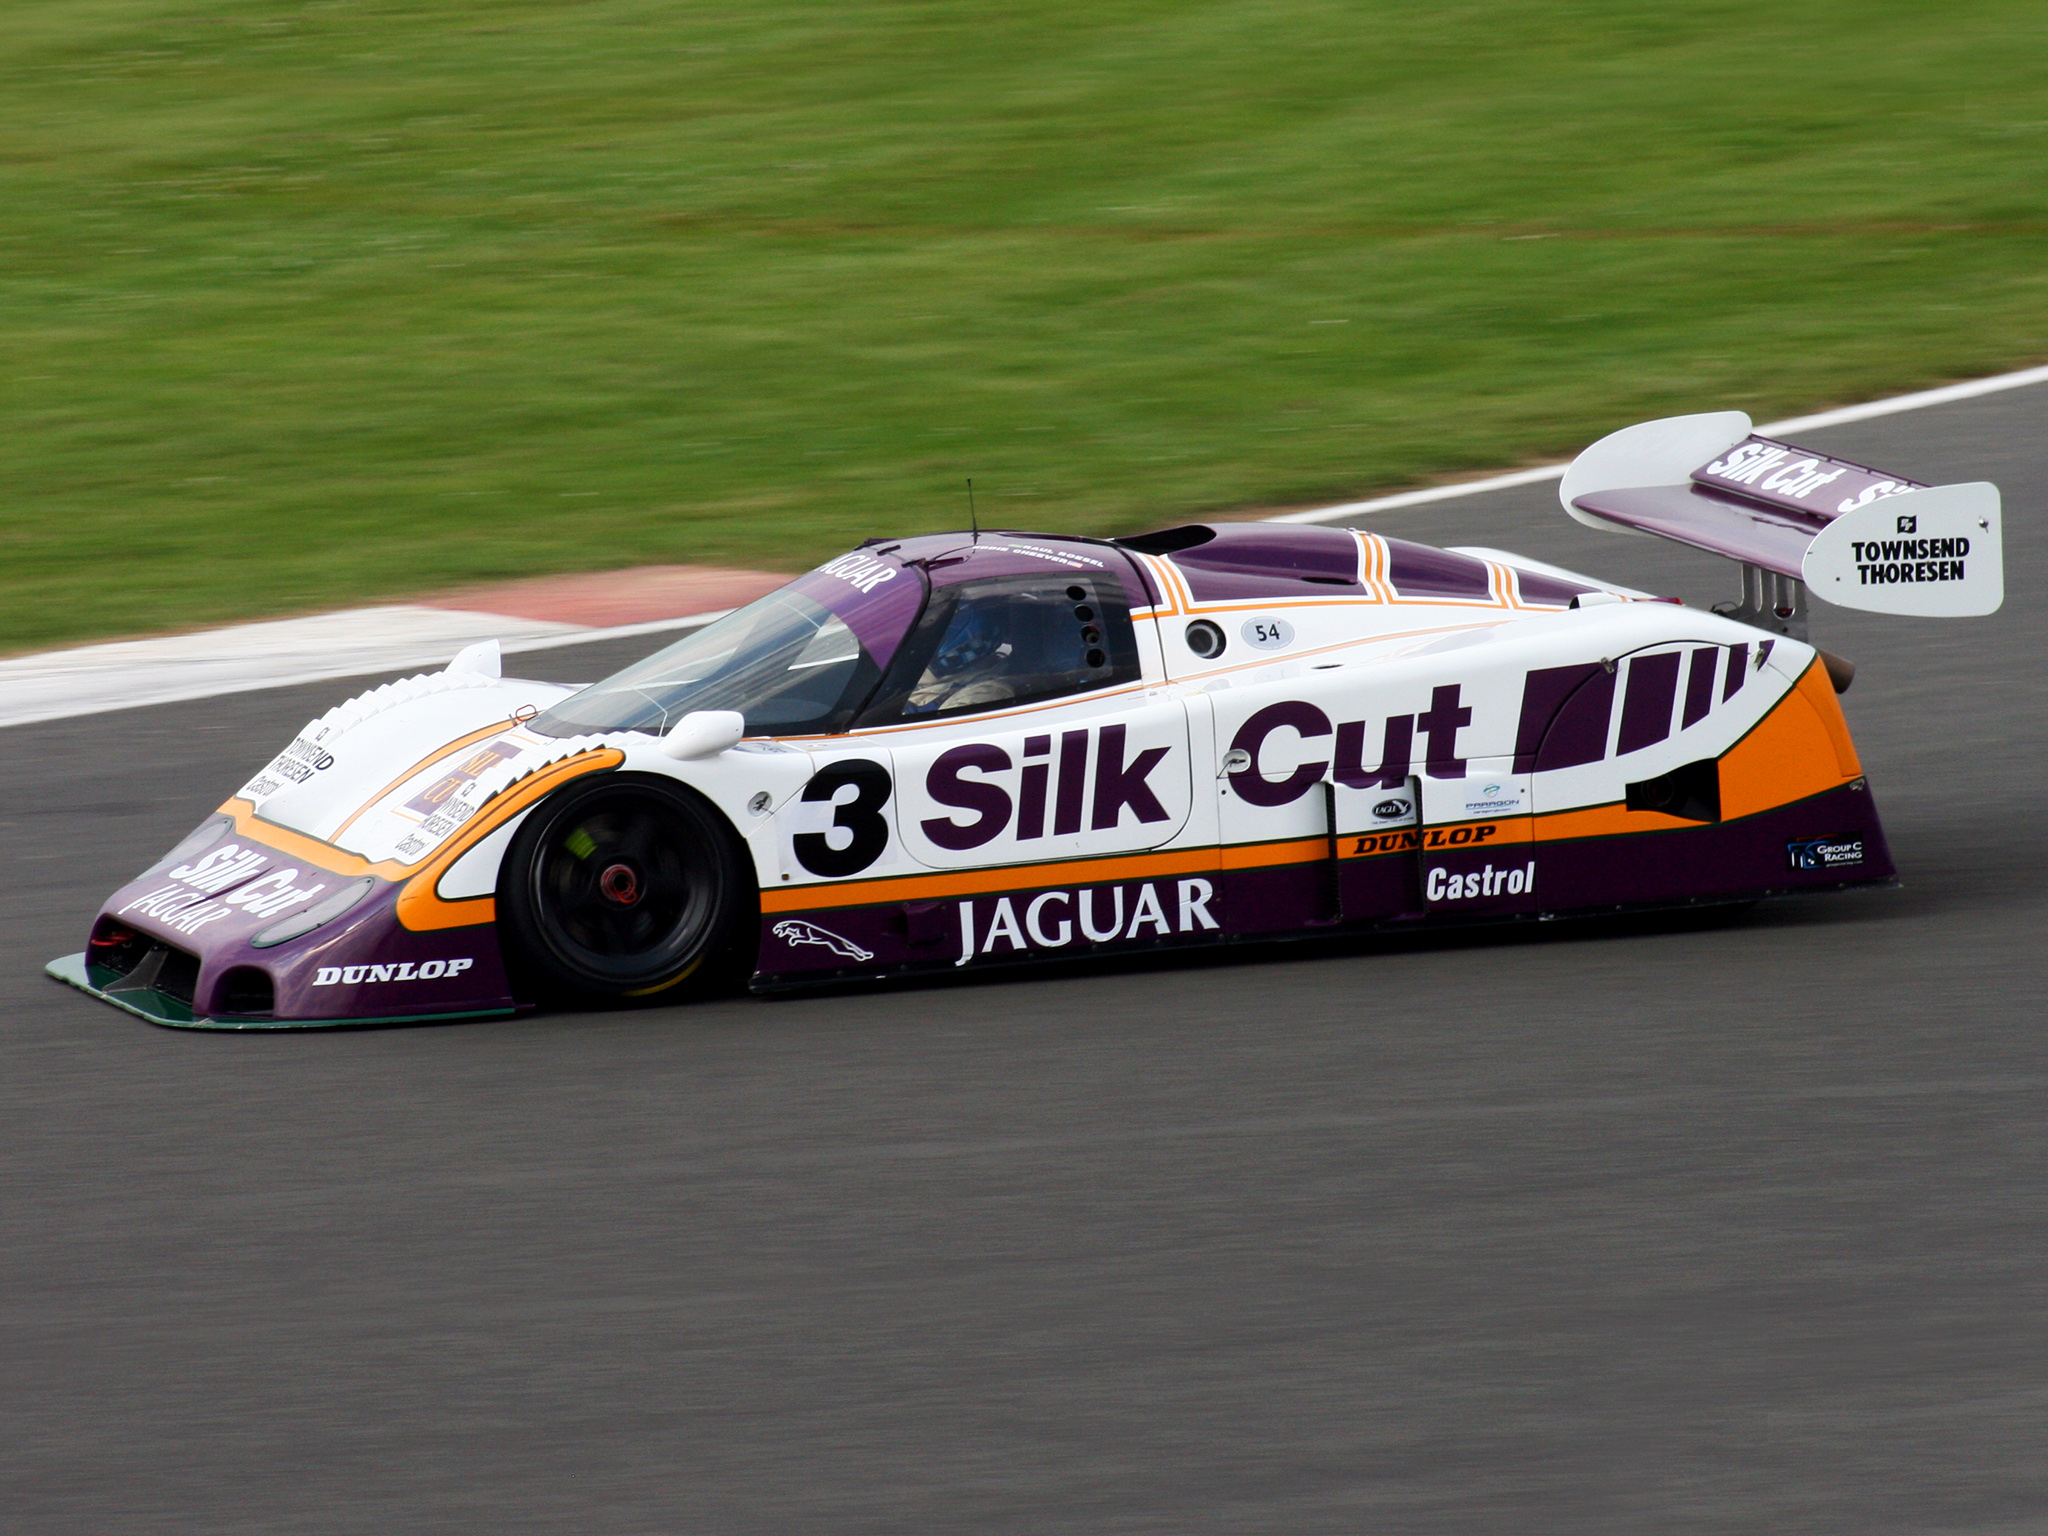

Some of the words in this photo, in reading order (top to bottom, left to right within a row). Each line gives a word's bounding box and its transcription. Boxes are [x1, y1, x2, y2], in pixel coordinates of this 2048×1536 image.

[1706, 443, 1790, 485] Silk
[1761, 458, 1847, 498] Cut
[1851, 537, 1970, 562] TOWNSEND
[813, 552, 897, 594] AGUAR
[1857, 560, 1965, 585] THORESEN
[1255, 623, 1280, 642] 54
[459, 750, 503, 777] SIL
[920, 723, 1172, 851] Silk
[1228, 683, 1472, 808] Cut
[793, 758, 892, 877] 3
[1466, 800, 1519, 808] PARAGON
[1353, 826, 1496, 854] DUNLOP
[1824, 852, 1863, 861] RACING
[169, 844, 268, 893] Silk
[225, 868, 325, 918] Cut
[1426, 861, 1536, 901] Castrol
[118, 883, 232, 935] JAGUAR
[955, 878, 1220, 967] JAGUAR
[312, 958, 473, 986] DUNLOP
